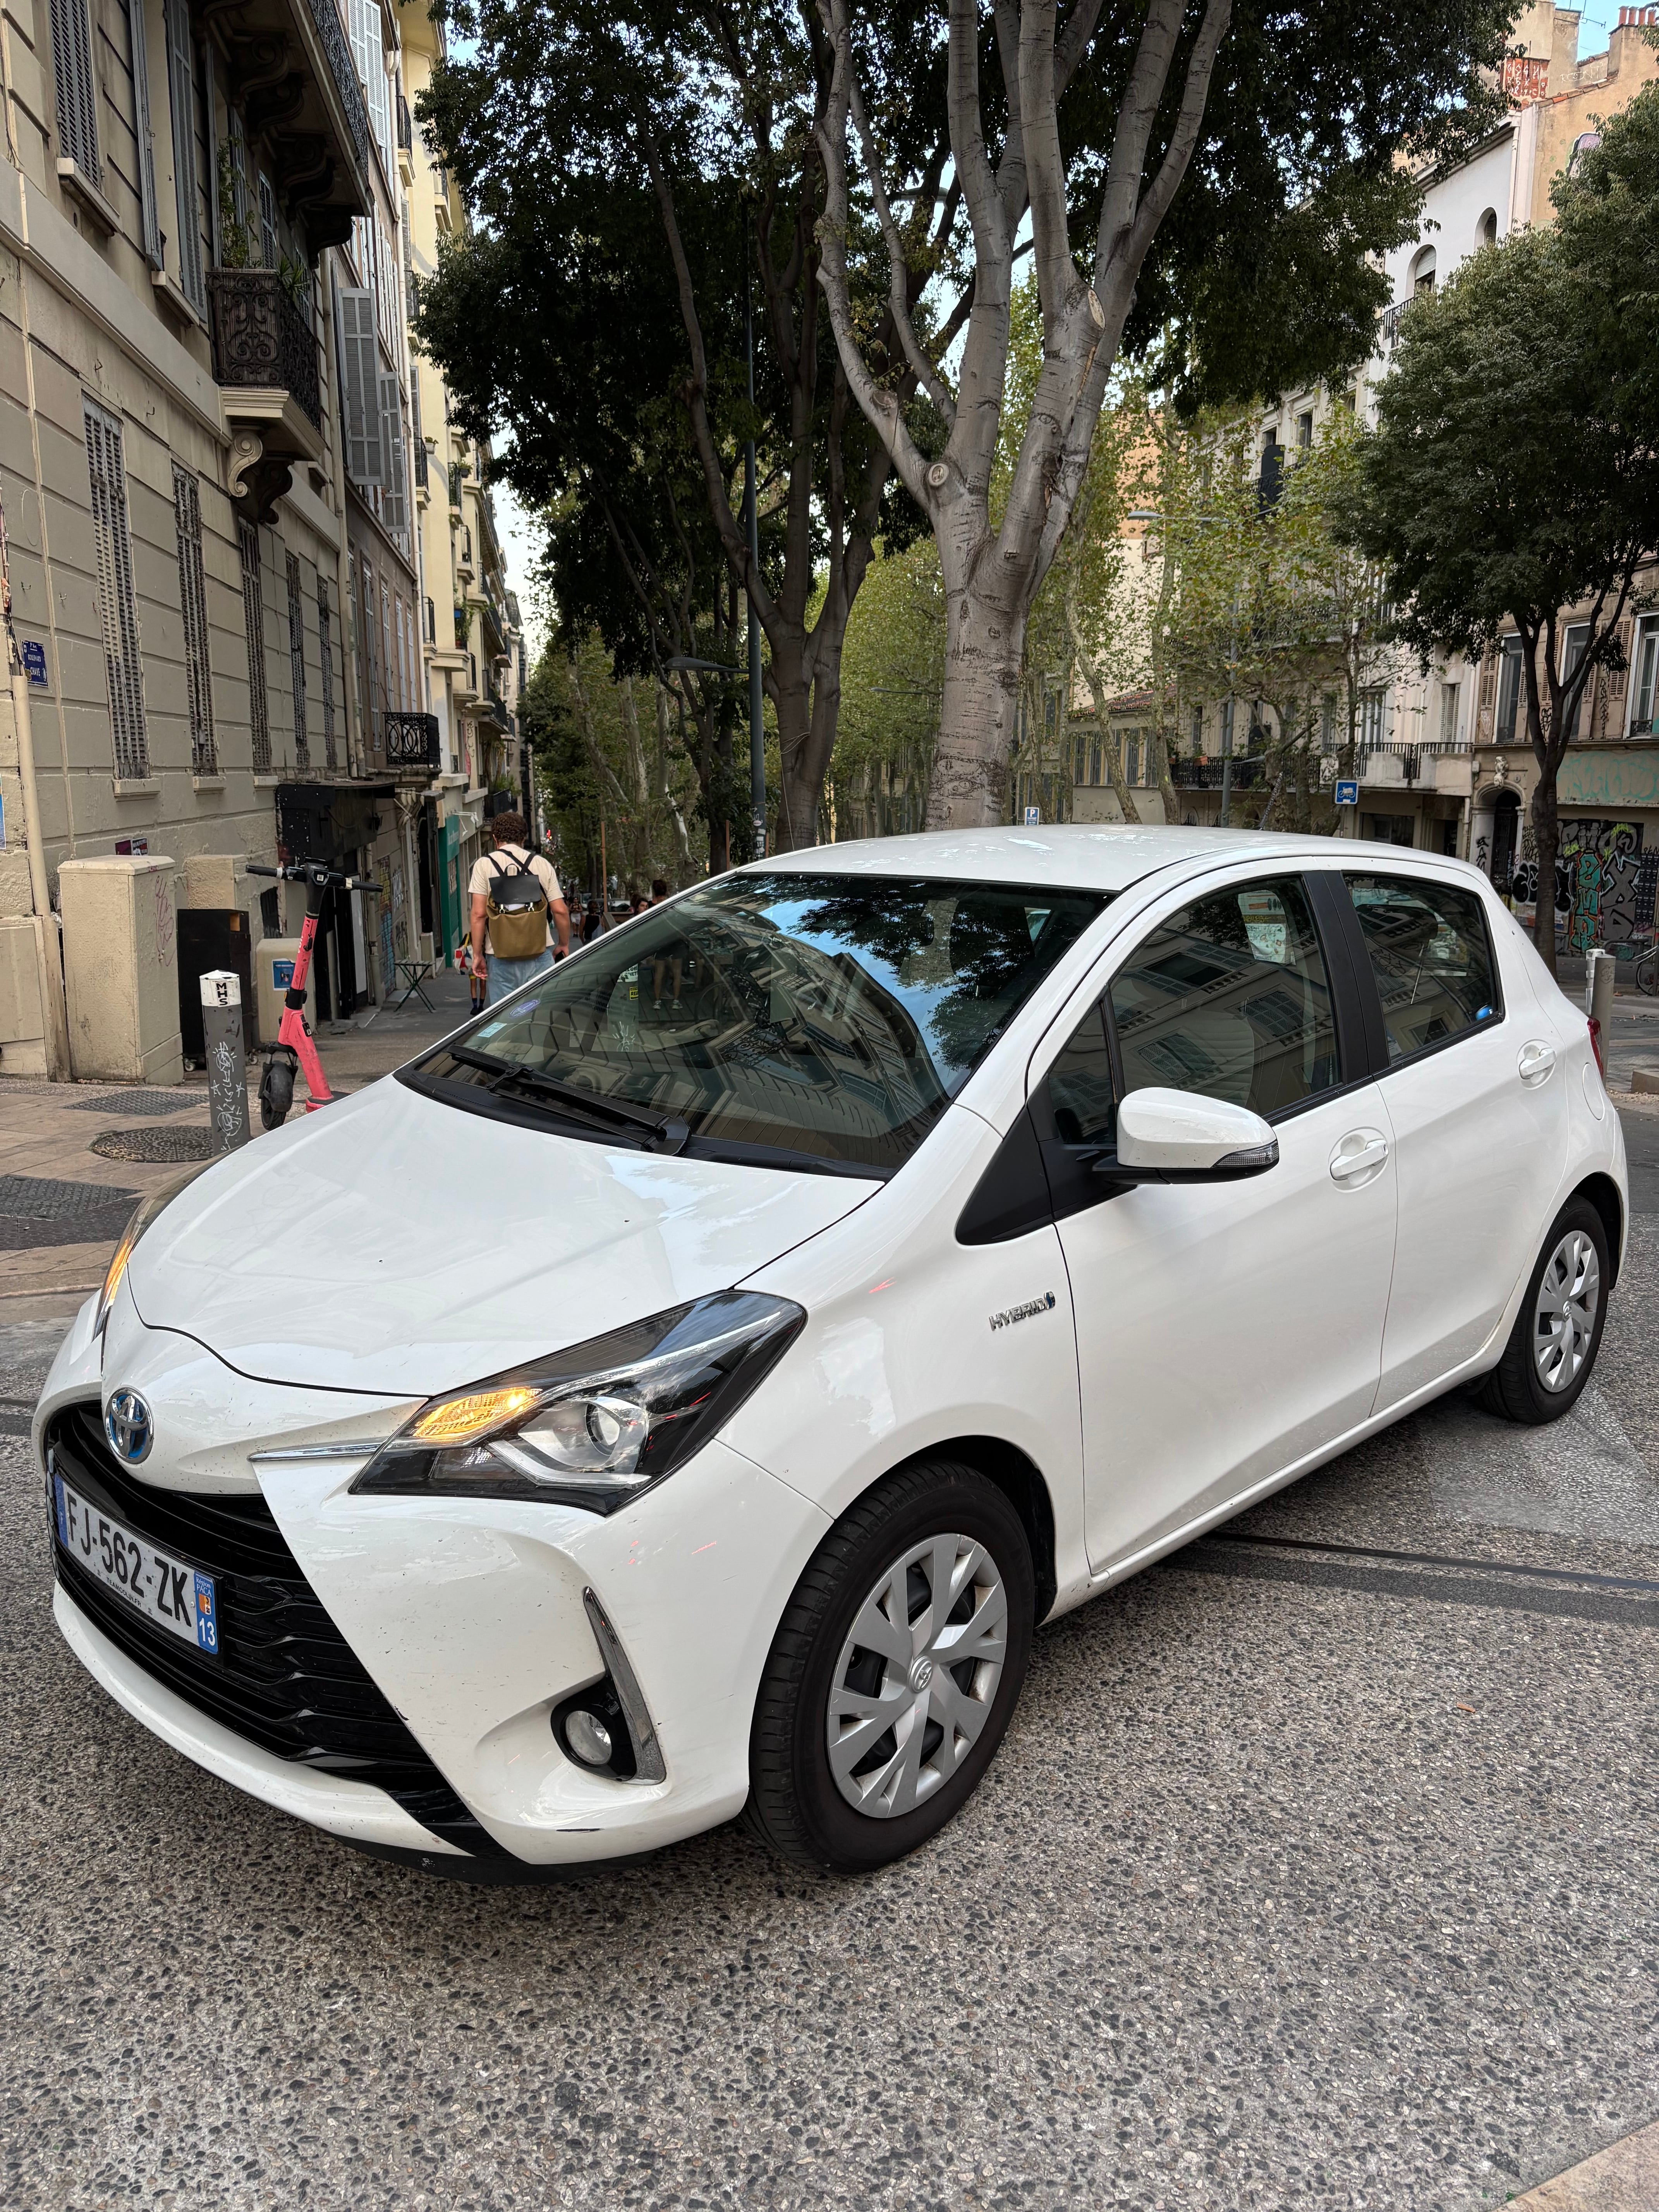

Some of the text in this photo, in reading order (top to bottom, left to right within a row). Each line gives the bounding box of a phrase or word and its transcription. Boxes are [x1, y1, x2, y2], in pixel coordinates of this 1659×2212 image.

[1030, 809, 1036, 817] P
[216, 982, 228, 1006] MHS
[989, 1297, 1046, 1331] HYBRID
[67, 1492, 192, 1627] FJ-562-ZK
[196, 1576, 211, 1589] Région
[196, 1583, 212, 1597] PACA
[199, 1618, 216, 1646] 13
